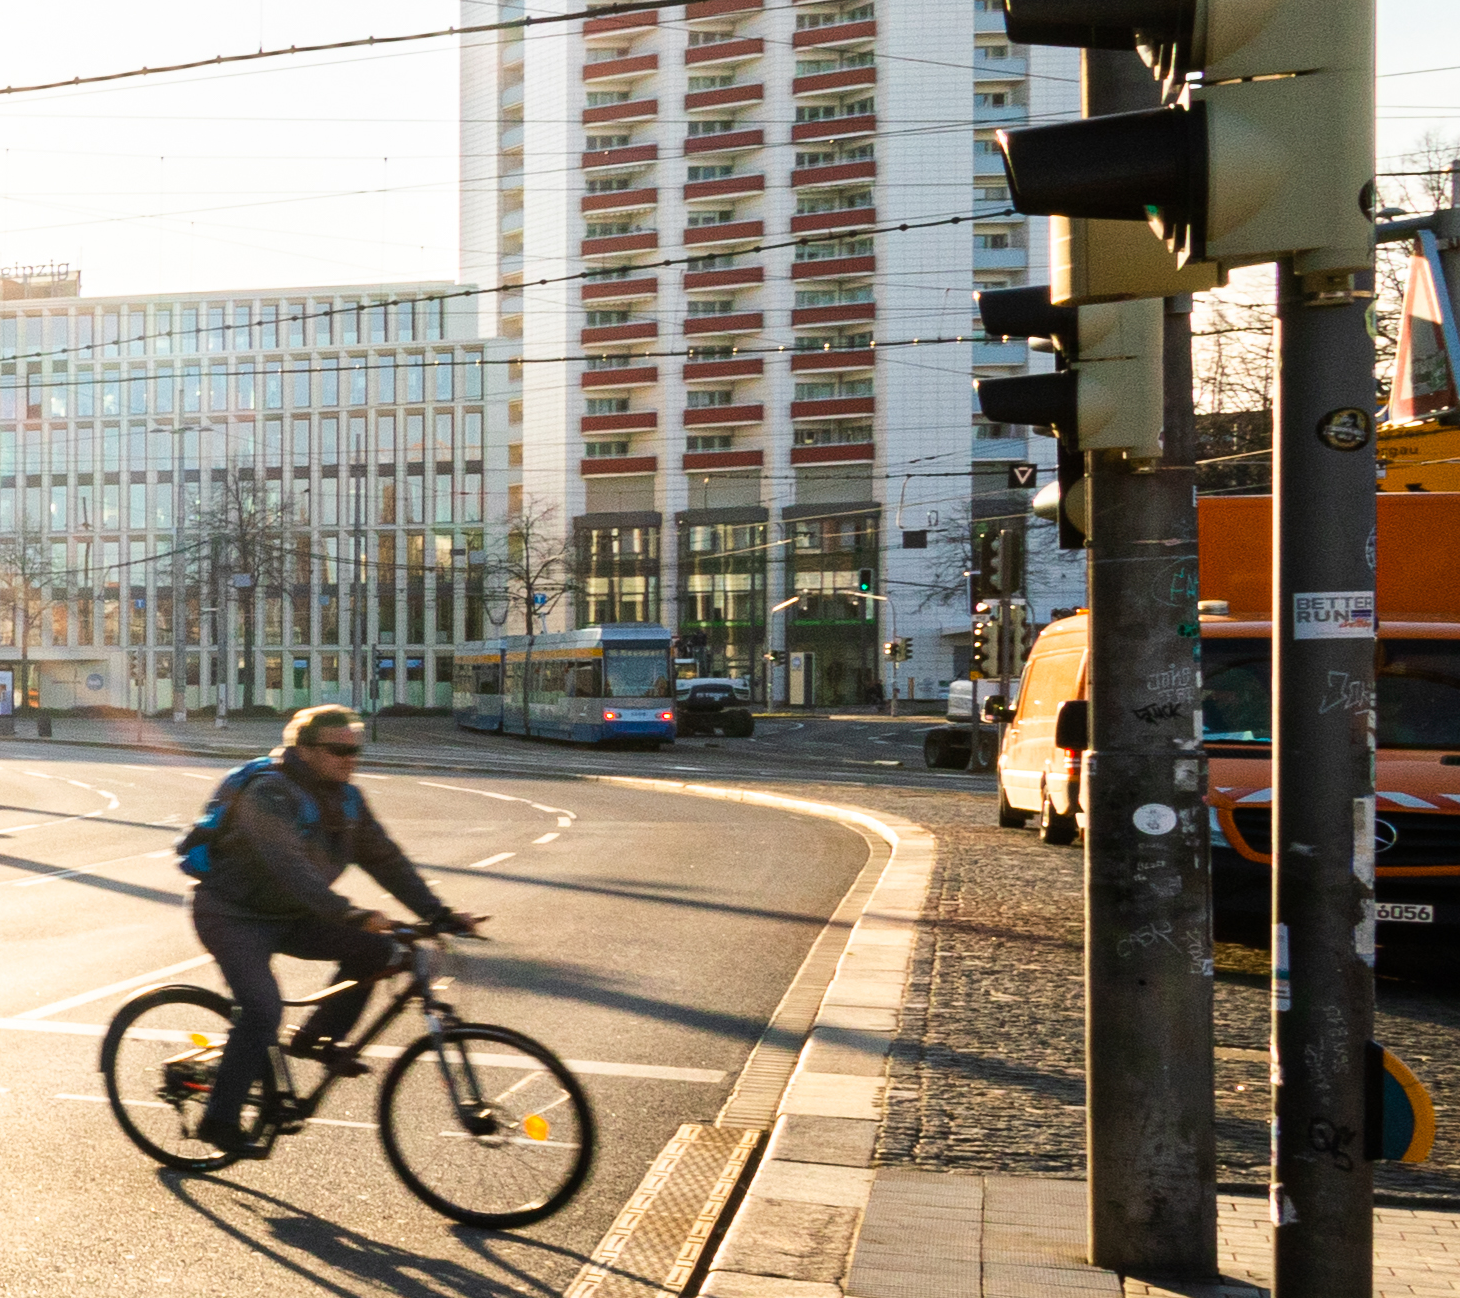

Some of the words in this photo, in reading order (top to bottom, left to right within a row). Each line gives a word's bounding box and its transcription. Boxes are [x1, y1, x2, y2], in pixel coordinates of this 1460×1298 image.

[1296, 596, 1372, 610] BETTER
[1296, 610, 1350, 623] RUN
[1377, 905, 1430, 921] 6056
